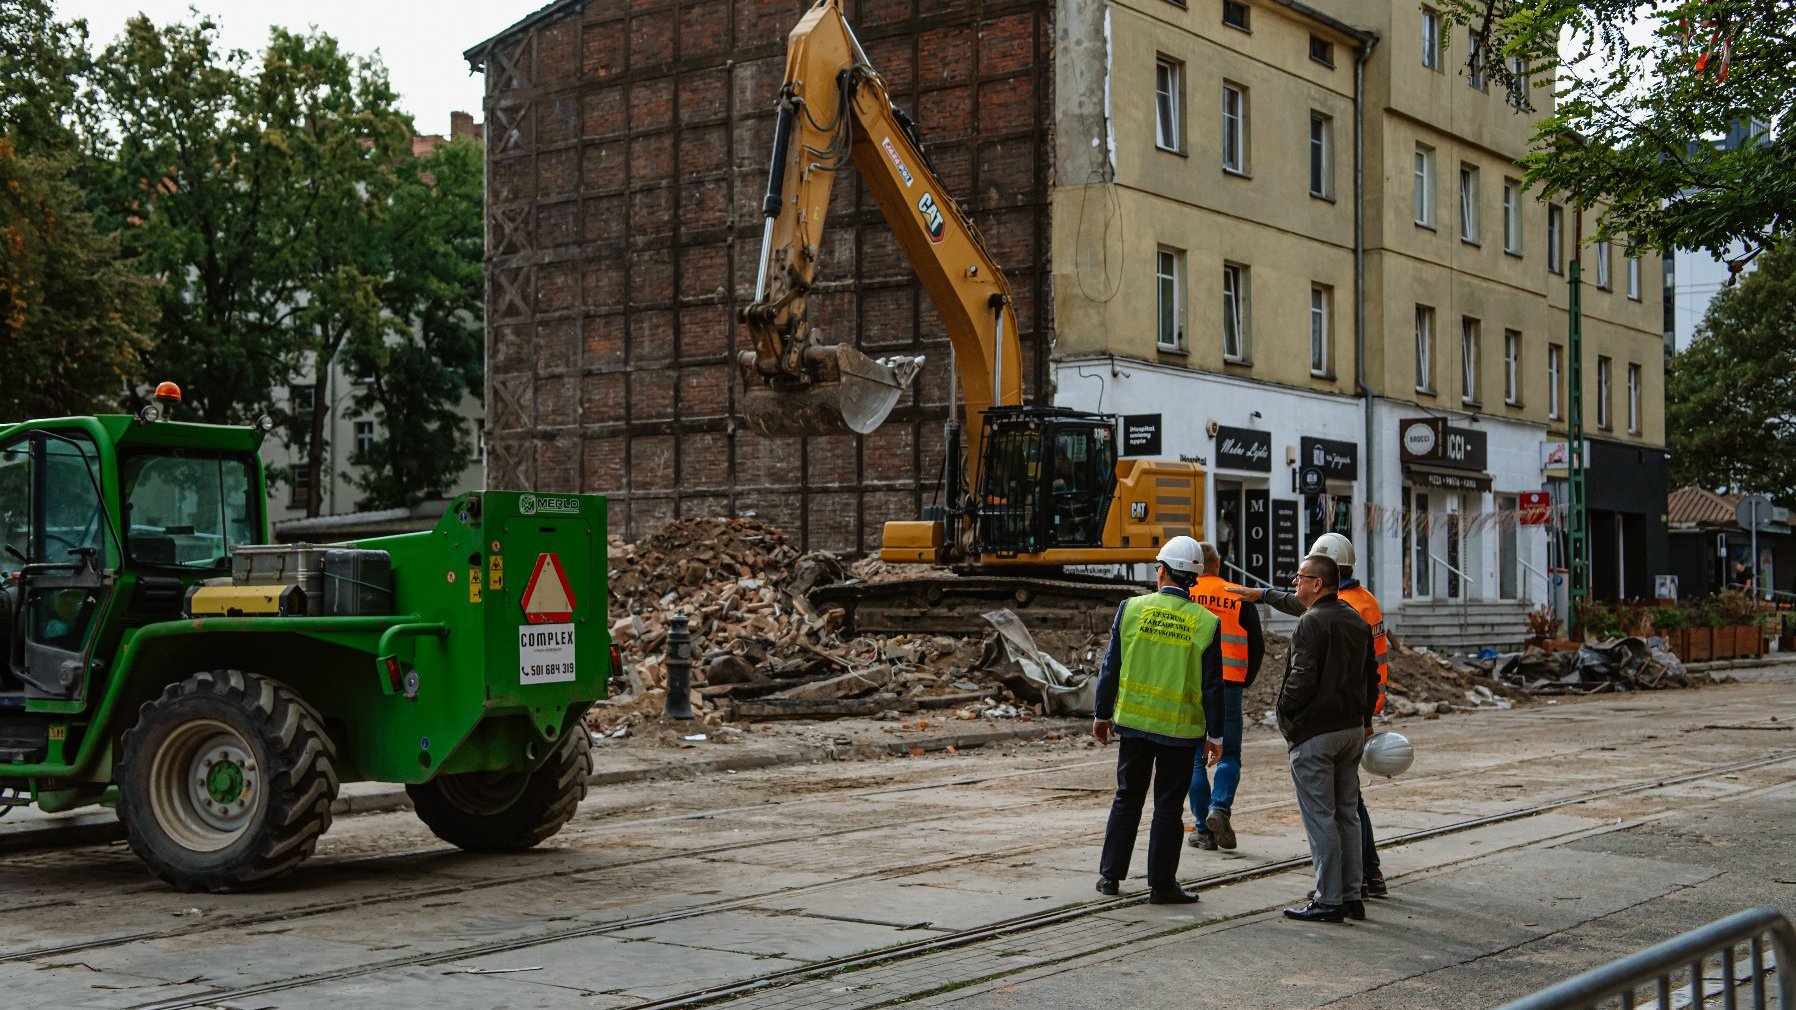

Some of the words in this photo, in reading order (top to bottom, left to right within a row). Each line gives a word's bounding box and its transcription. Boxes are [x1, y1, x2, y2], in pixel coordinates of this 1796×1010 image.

[918, 192, 943, 232] CAT
[1409, 435, 1430, 443] BROCCI
[537, 498, 579, 510] MERLO
[1131, 502, 1146, 518] CAT
[1190, 595, 1237, 610] OMPLEX
[1152, 611, 1185, 623] CENTRUM
[521, 631, 573, 647] COMPLEX
[1139, 626, 1191, 641] KRYZYSOWEGO
[531, 665, 543, 676] 501
[546, 664, 560, 675] 684
[562, 663, 574, 674] 319
